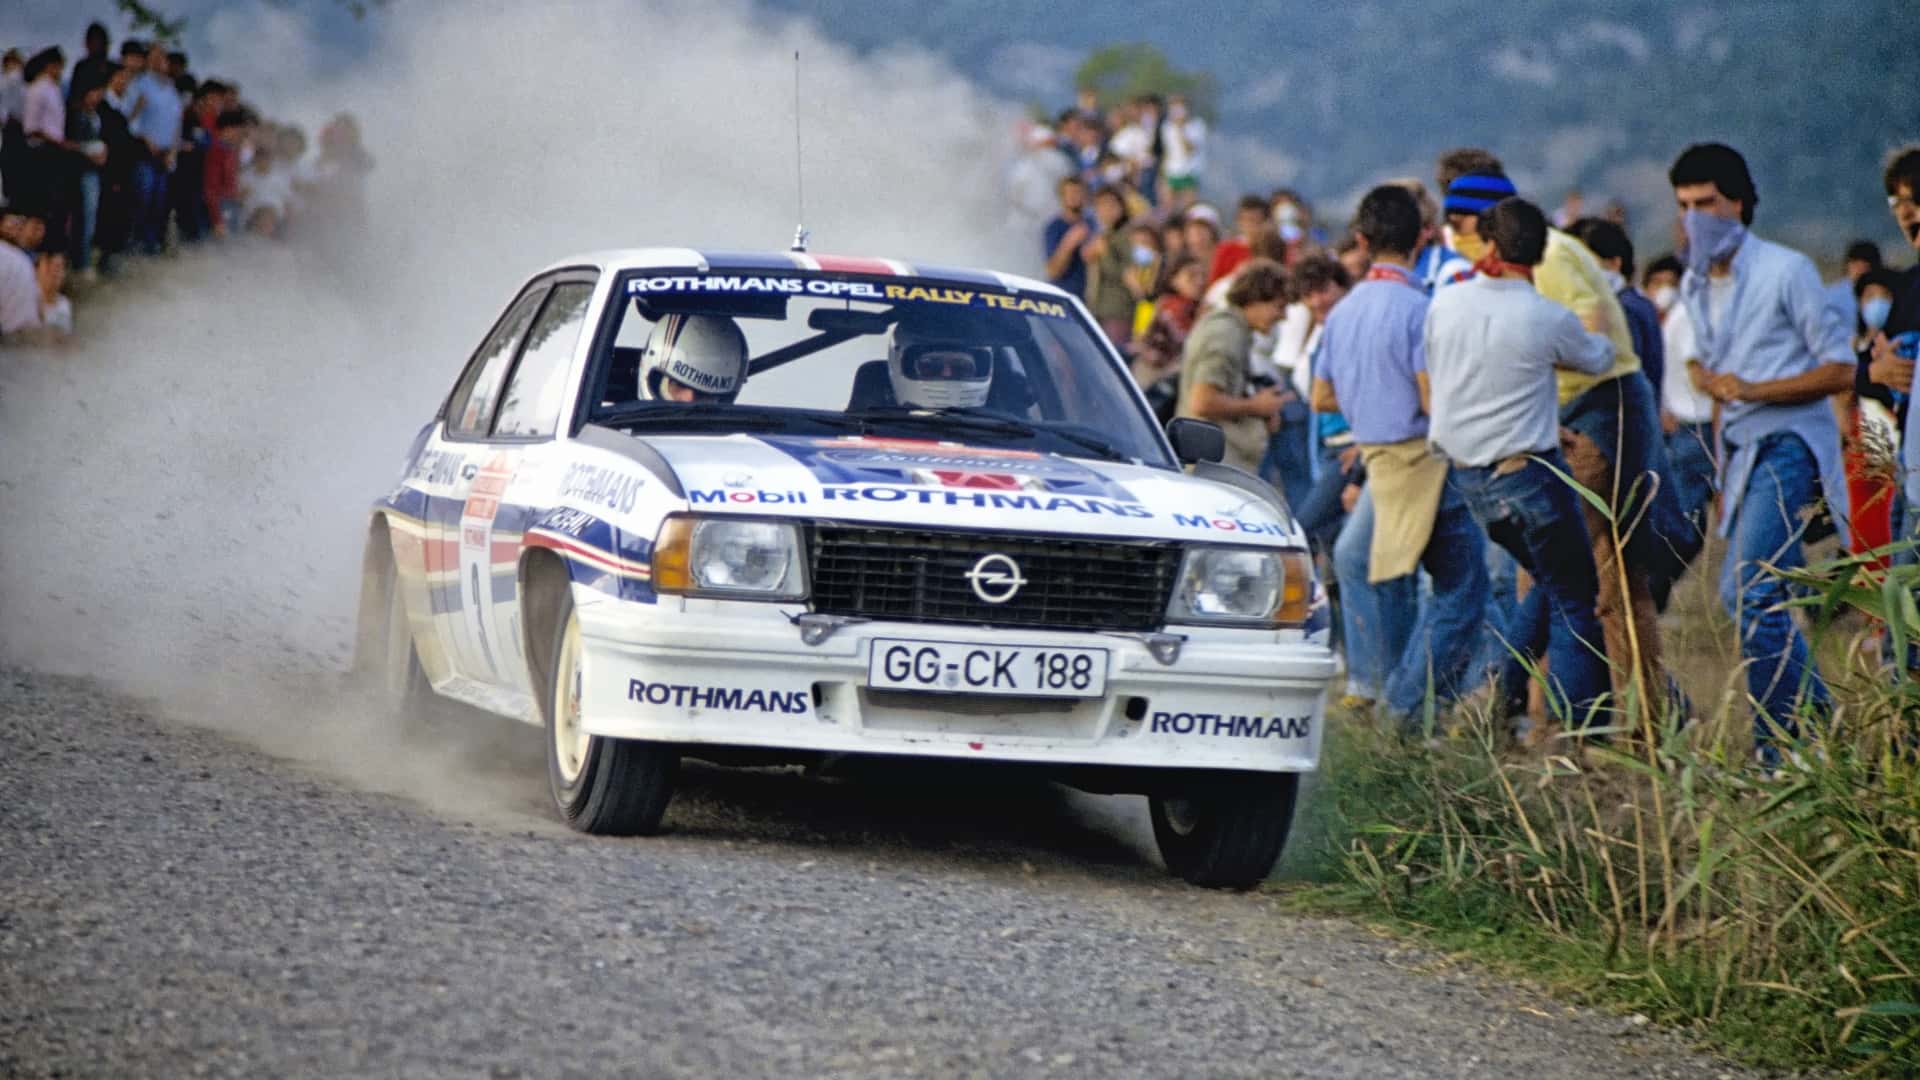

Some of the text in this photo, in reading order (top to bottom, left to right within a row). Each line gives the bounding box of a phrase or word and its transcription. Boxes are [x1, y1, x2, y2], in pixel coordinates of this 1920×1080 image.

[628, 276, 1067, 318] ROTHMANS OPEL RALLY TEAM
[672, 360, 734, 389] ROTHMANS
[689, 489, 808, 504] Mobil
[822, 486, 1155, 519] ROTHMANS
[1172, 512, 1287, 537] Mobil
[884, 645, 1093, 690] GG-CK 188
[628, 677, 809, 714] ROTHMANS
[1151, 711, 1311, 739] ROTHMANS
